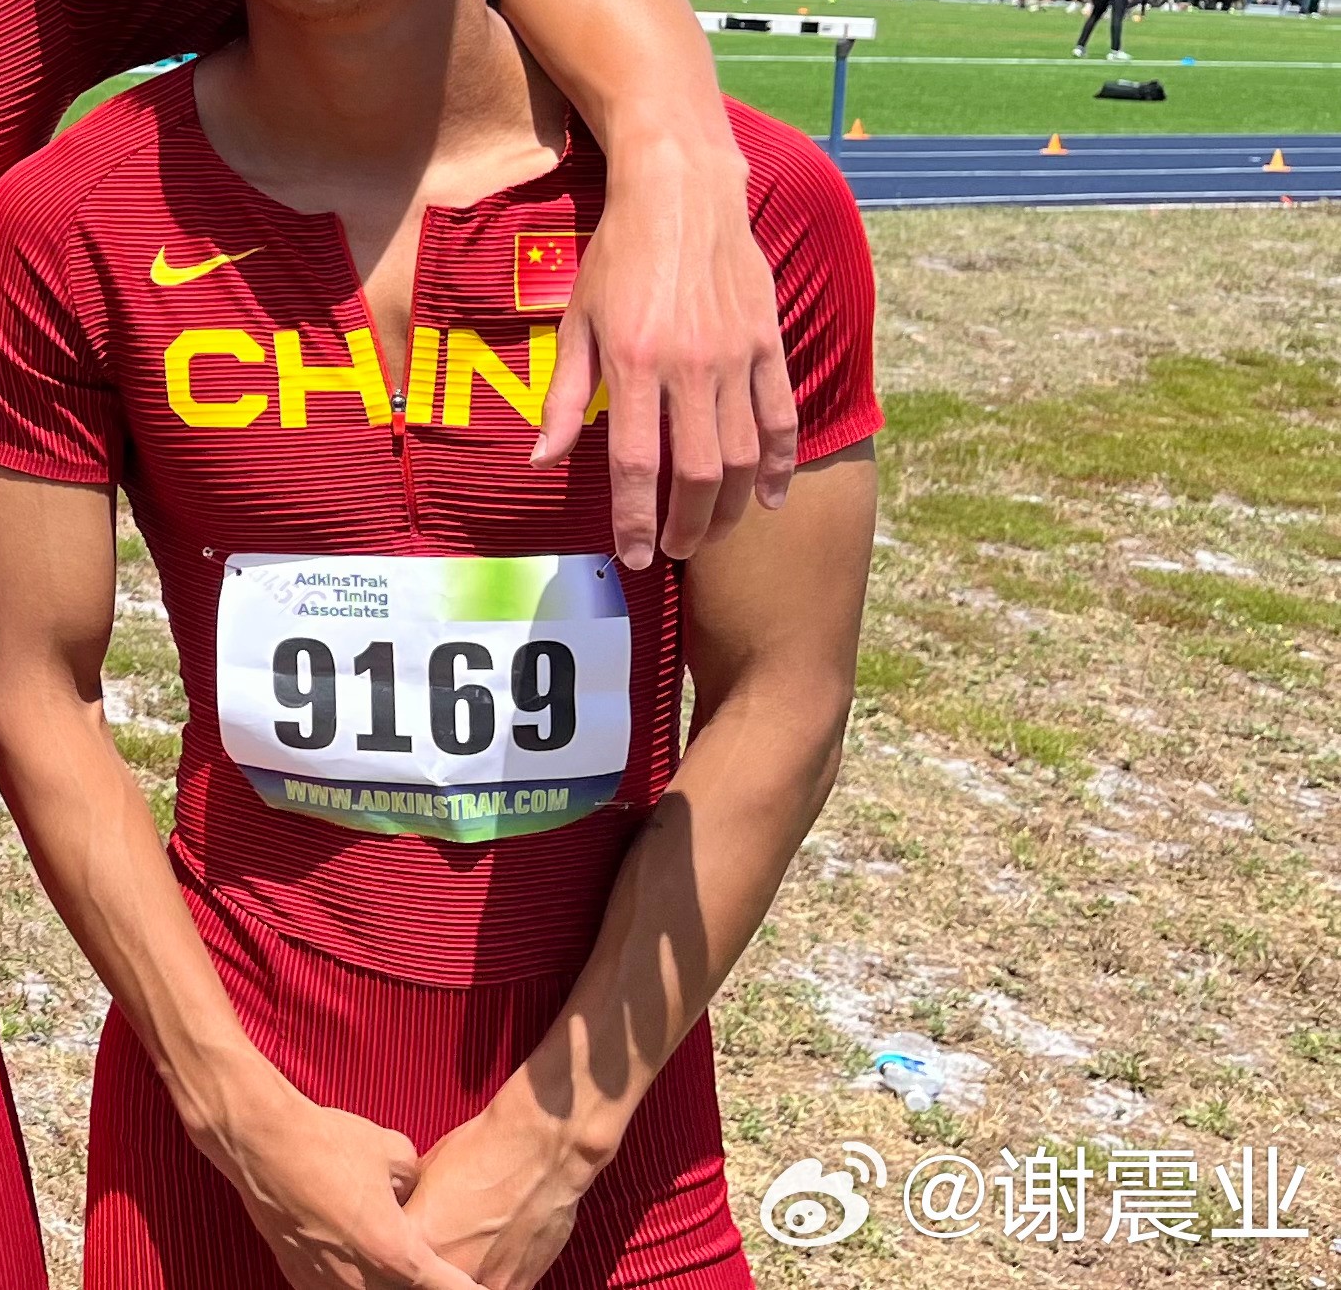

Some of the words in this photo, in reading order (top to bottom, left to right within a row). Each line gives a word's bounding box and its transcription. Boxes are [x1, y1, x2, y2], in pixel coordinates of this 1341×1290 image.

[163, 326, 608, 429] CHIN
[294, 573, 388, 588] AdkinsTrak
[298, 603, 389, 618] Associates
[333, 589, 388, 605] Timing
[271, 636, 578, 757] 9169
[284, 778, 569, 821] WWW.ADKINSTRAK.COM
